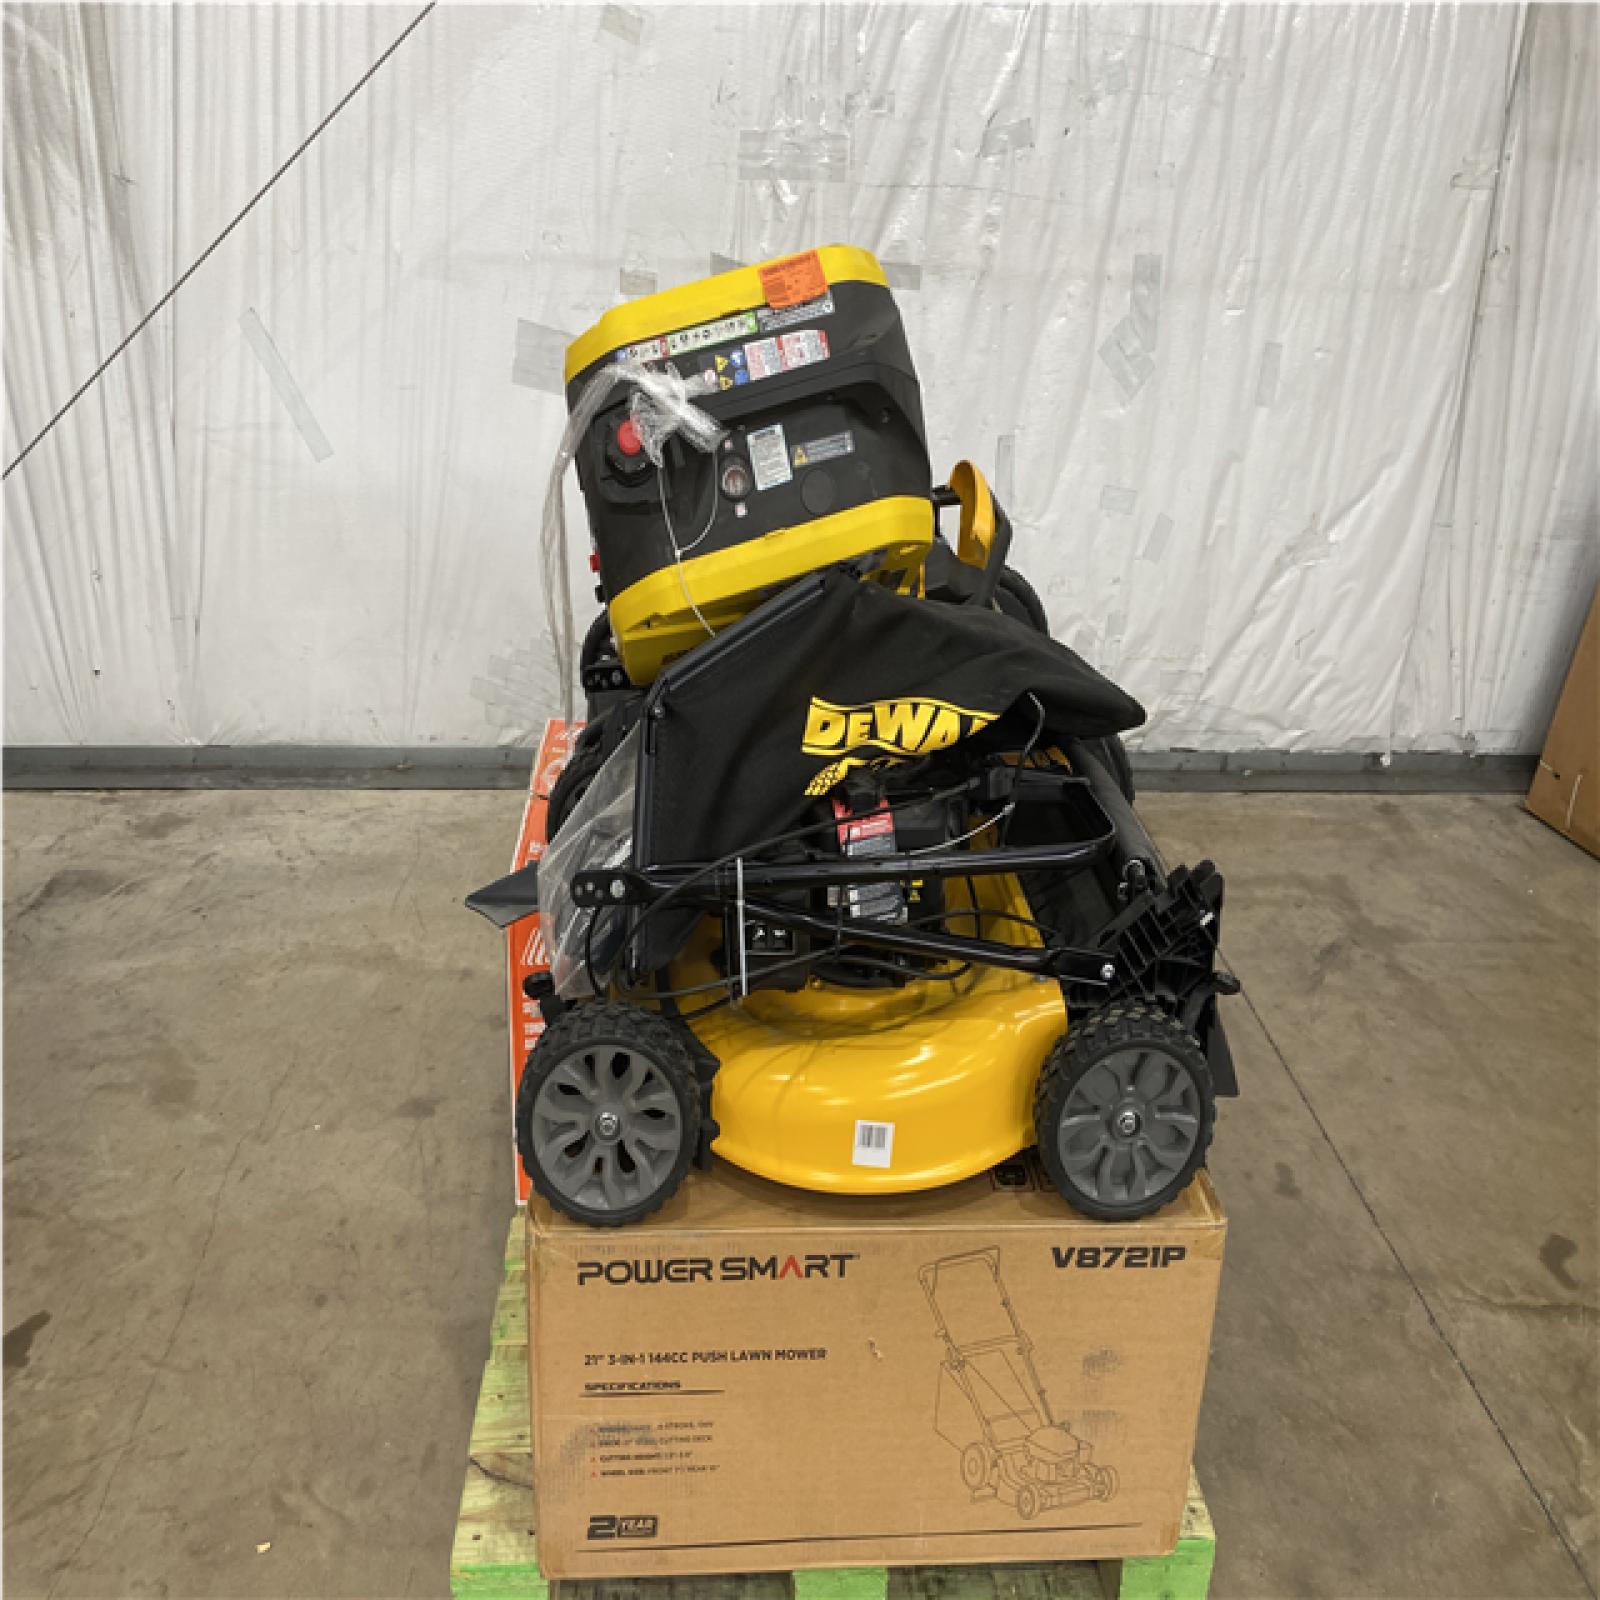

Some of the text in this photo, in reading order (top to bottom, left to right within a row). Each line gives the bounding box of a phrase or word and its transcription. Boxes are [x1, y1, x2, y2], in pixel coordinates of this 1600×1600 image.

[803, 702, 990, 753] DEWA
[577, 1254, 853, 1285] POWER SMART
[692, 1351, 728, 1363] PUSH
[730, 1349, 771, 1361] LAWN
[775, 1348, 828, 1361] MOWER
[584, 1380, 681, 1391] SPECIFICATIONS
[588, 1515, 616, 1540] 2
